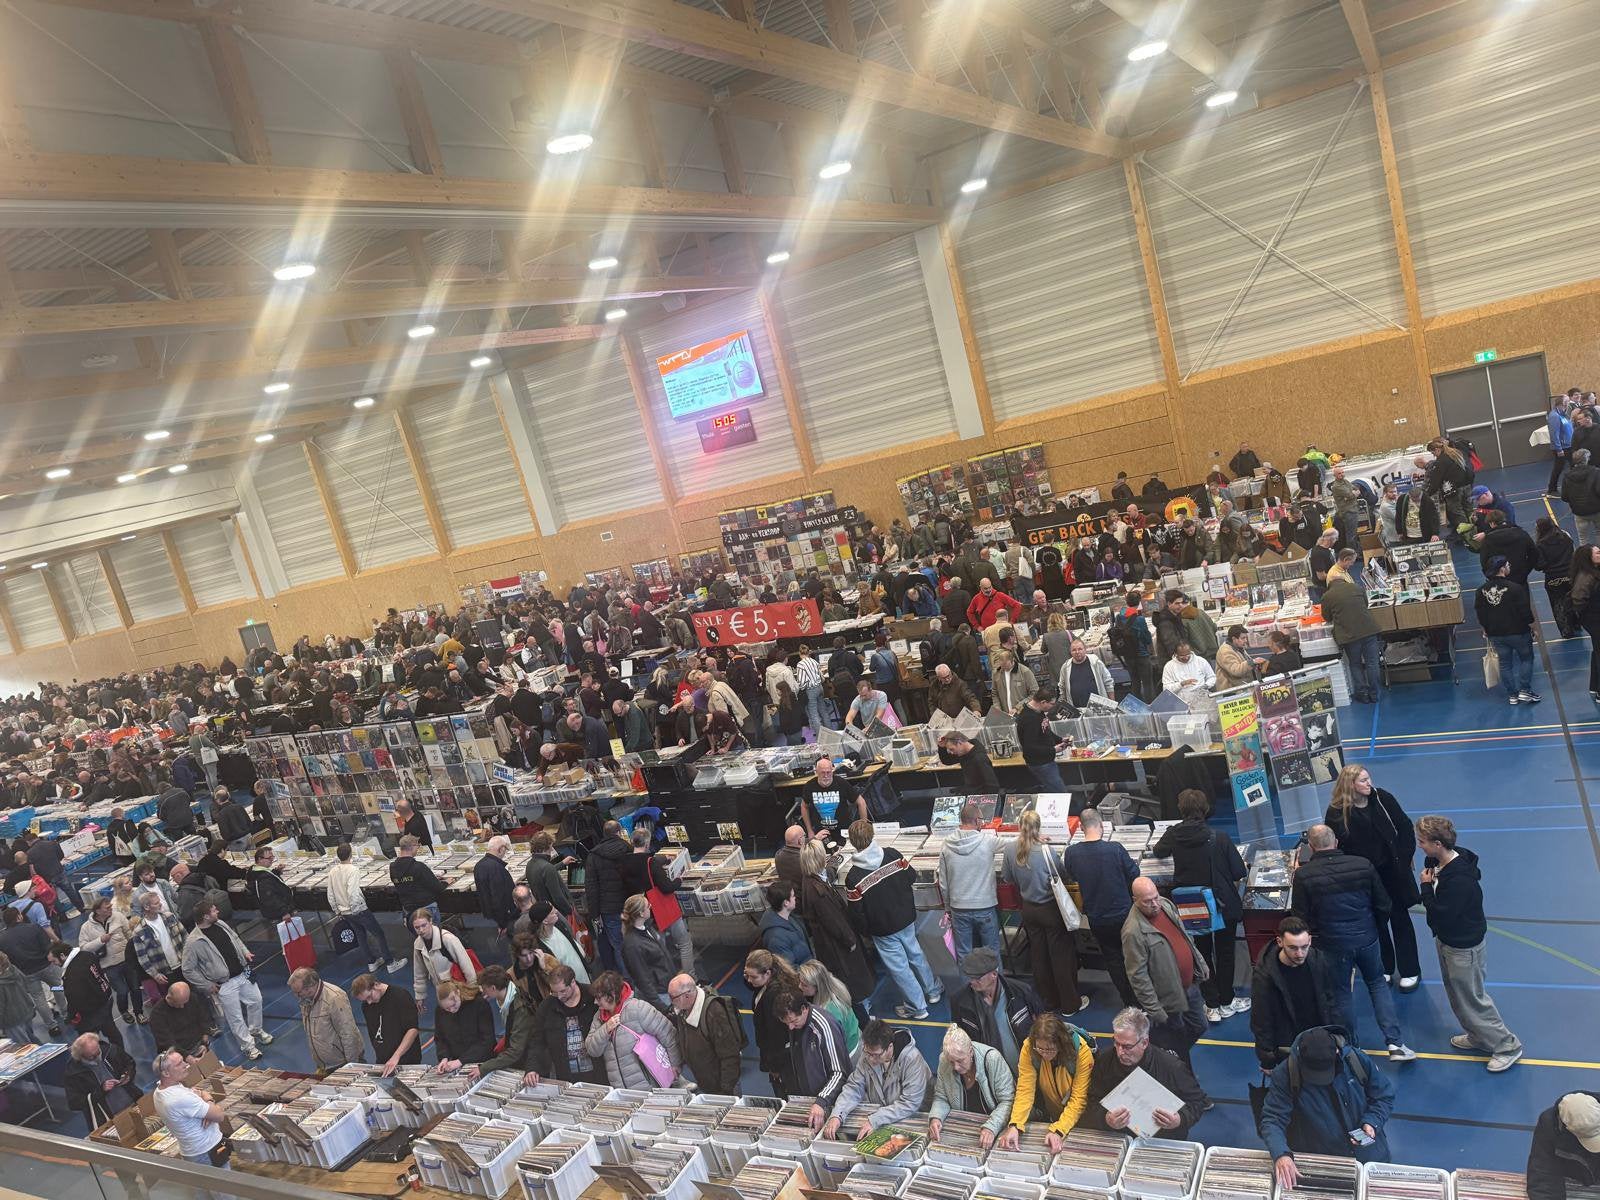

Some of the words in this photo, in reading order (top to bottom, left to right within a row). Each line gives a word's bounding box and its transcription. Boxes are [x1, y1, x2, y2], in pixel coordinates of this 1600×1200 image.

[1059, 521, 1096, 540] BACK
[695, 614, 724, 628] SALE
[1223, 701, 1238, 709] NEVER
